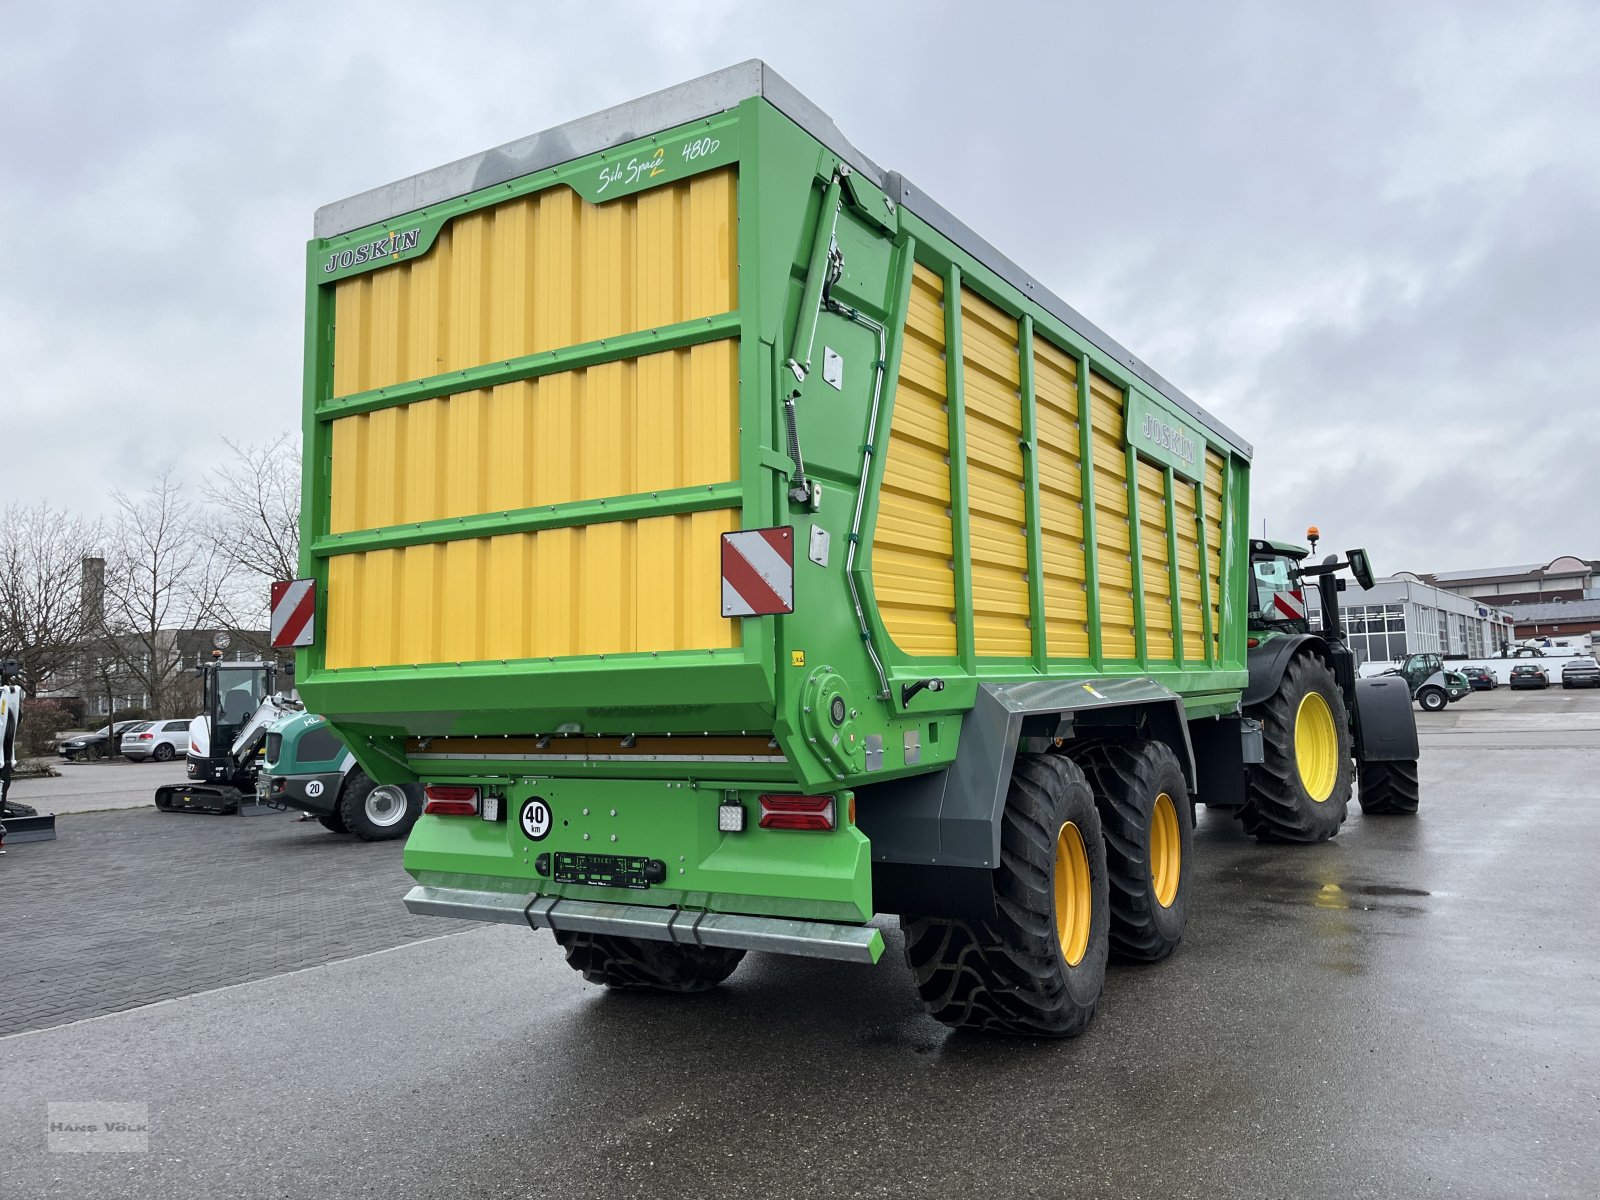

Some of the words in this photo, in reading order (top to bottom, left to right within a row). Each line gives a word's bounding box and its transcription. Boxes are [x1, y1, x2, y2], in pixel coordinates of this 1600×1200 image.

[597, 163, 622, 193] Silo
[325, 228, 421, 273] JOSKIN
[1143, 412, 1196, 464] JOSKIN
[309, 783, 320, 795] 20
[525, 805, 544, 824] 40
[531, 824, 541, 833] km
